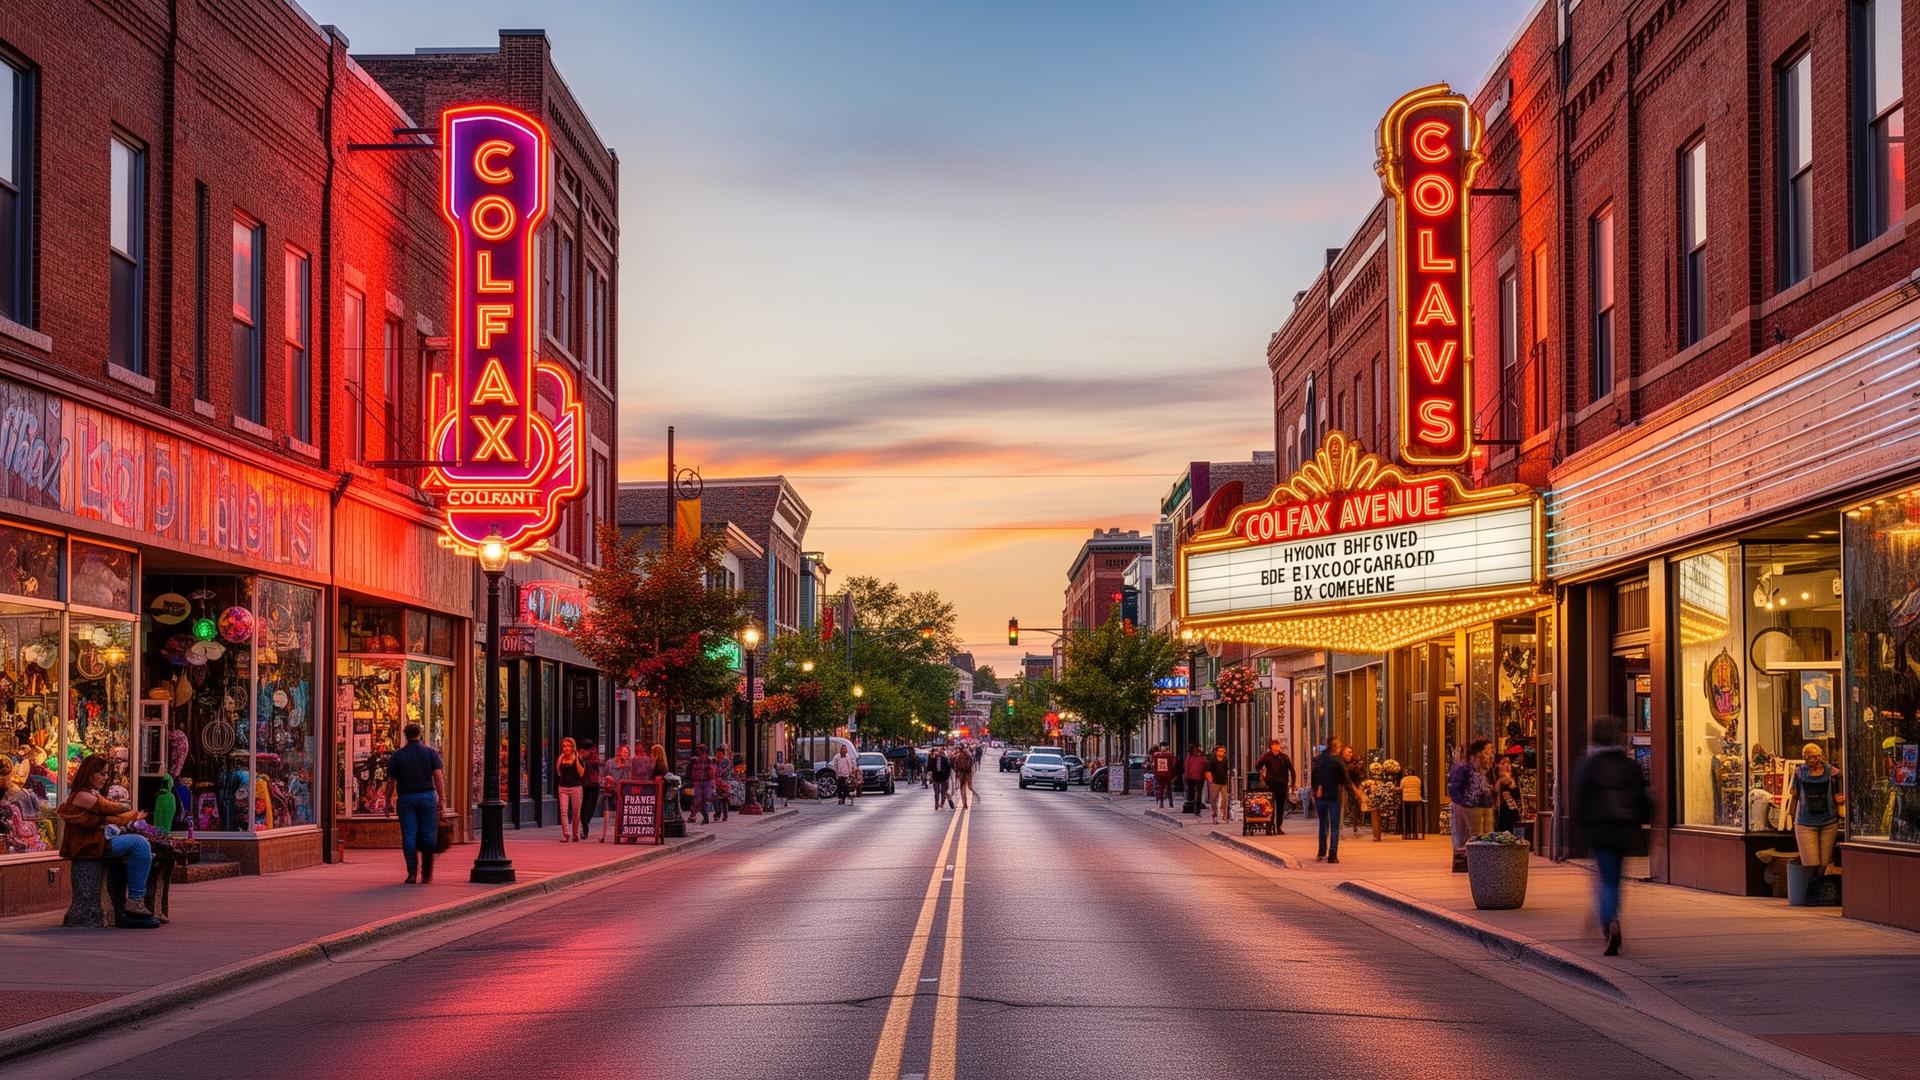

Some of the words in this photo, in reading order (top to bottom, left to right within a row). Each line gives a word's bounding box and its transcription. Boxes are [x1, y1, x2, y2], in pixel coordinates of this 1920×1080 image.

[471, 140, 518, 461] COLFAX
[1412, 122, 1456, 443] COLAVS
[1246, 502, 1330, 541] COLFAX
[1340, 485, 1439, 529] AVENUE
[1294, 585, 1312, 601] BX
